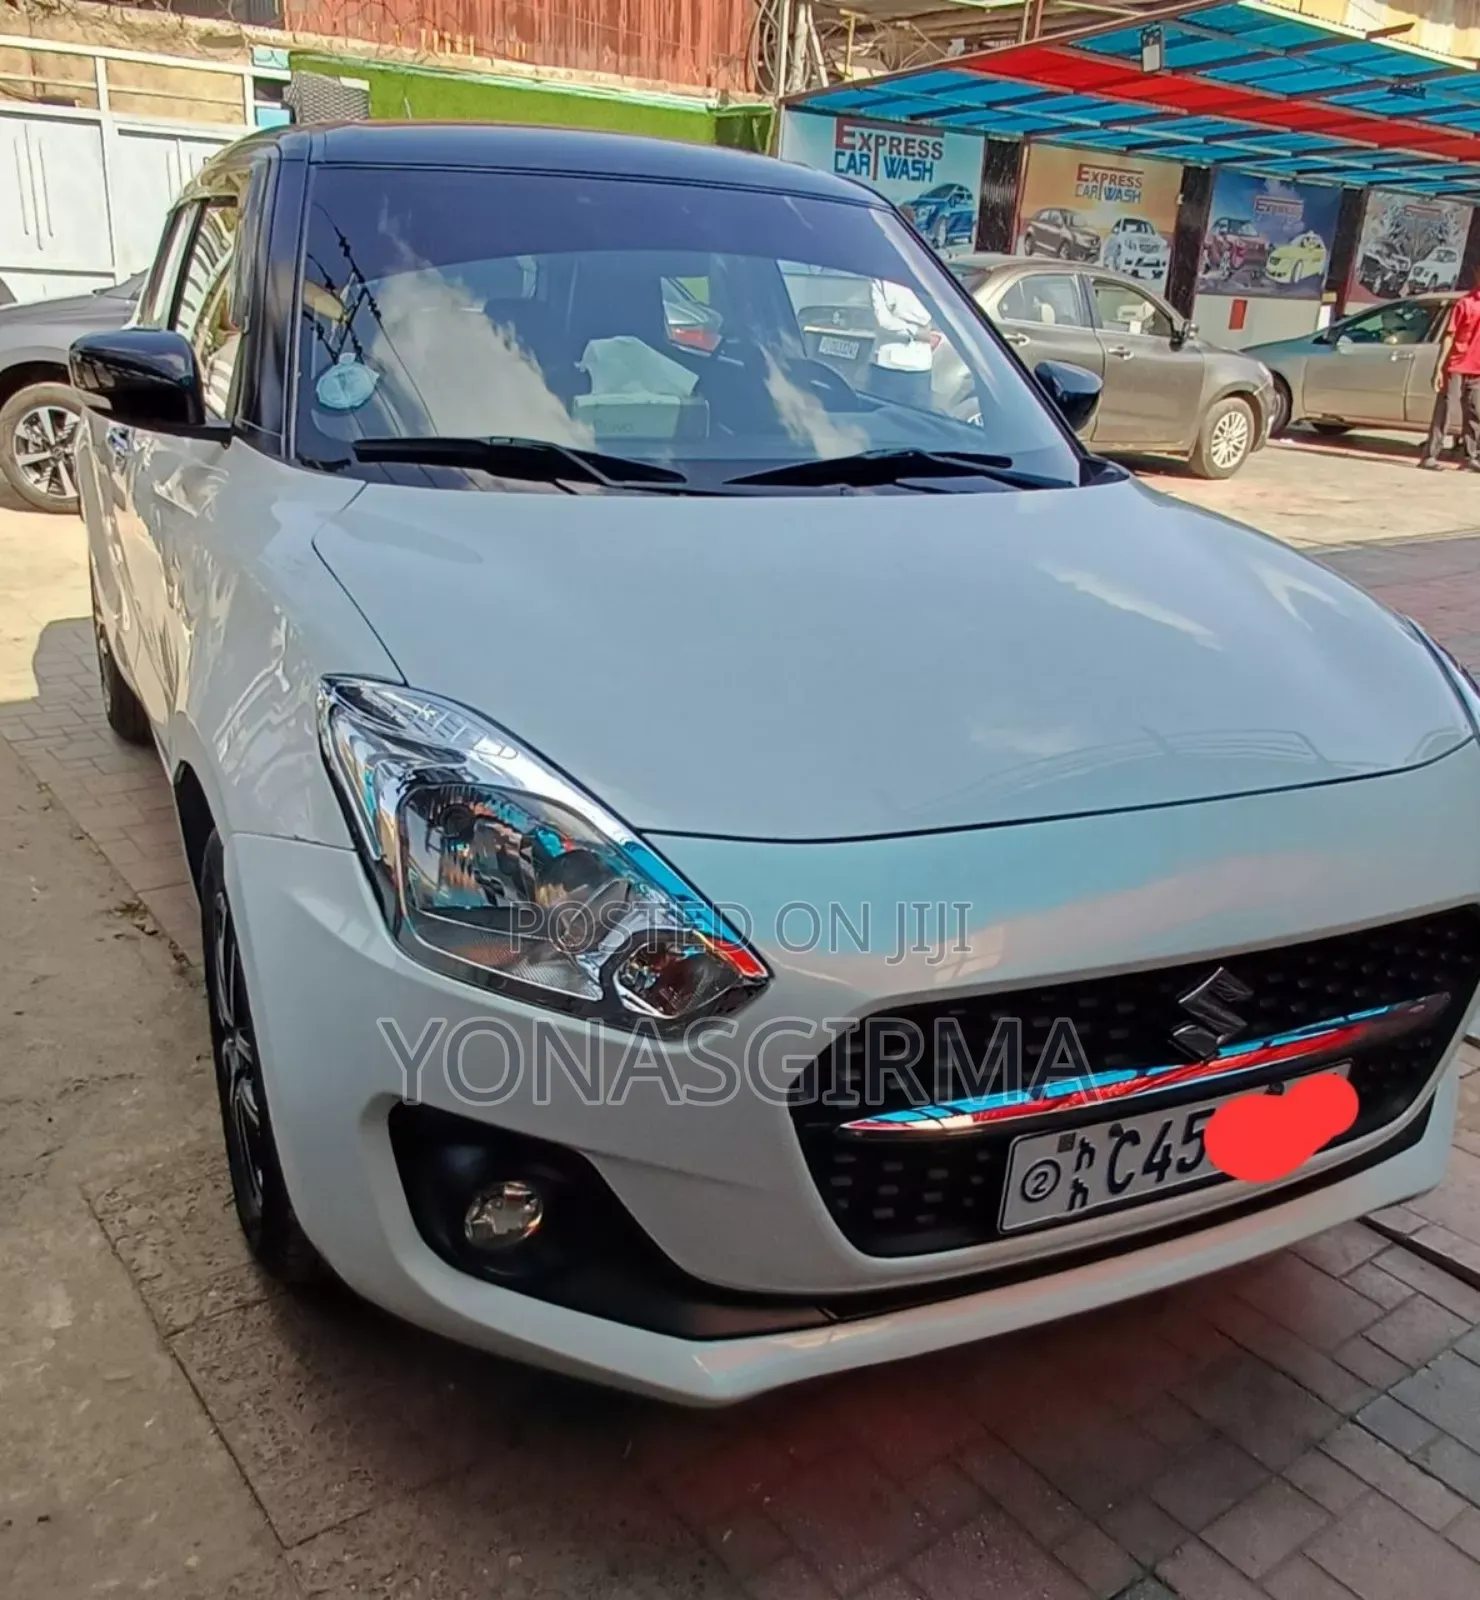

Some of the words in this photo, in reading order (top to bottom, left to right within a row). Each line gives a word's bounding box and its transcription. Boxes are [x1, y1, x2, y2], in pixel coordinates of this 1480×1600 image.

[834, 150, 870, 177] CAR
[884, 156, 934, 183] WASH
[836, 117, 945, 180] EXPRESS
[1074, 184, 1099, 199] CAR
[1104, 186, 1142, 205] WASH
[1076, 163, 1145, 201] EXPRESS
[1107, 1108, 1216, 1195] C45
